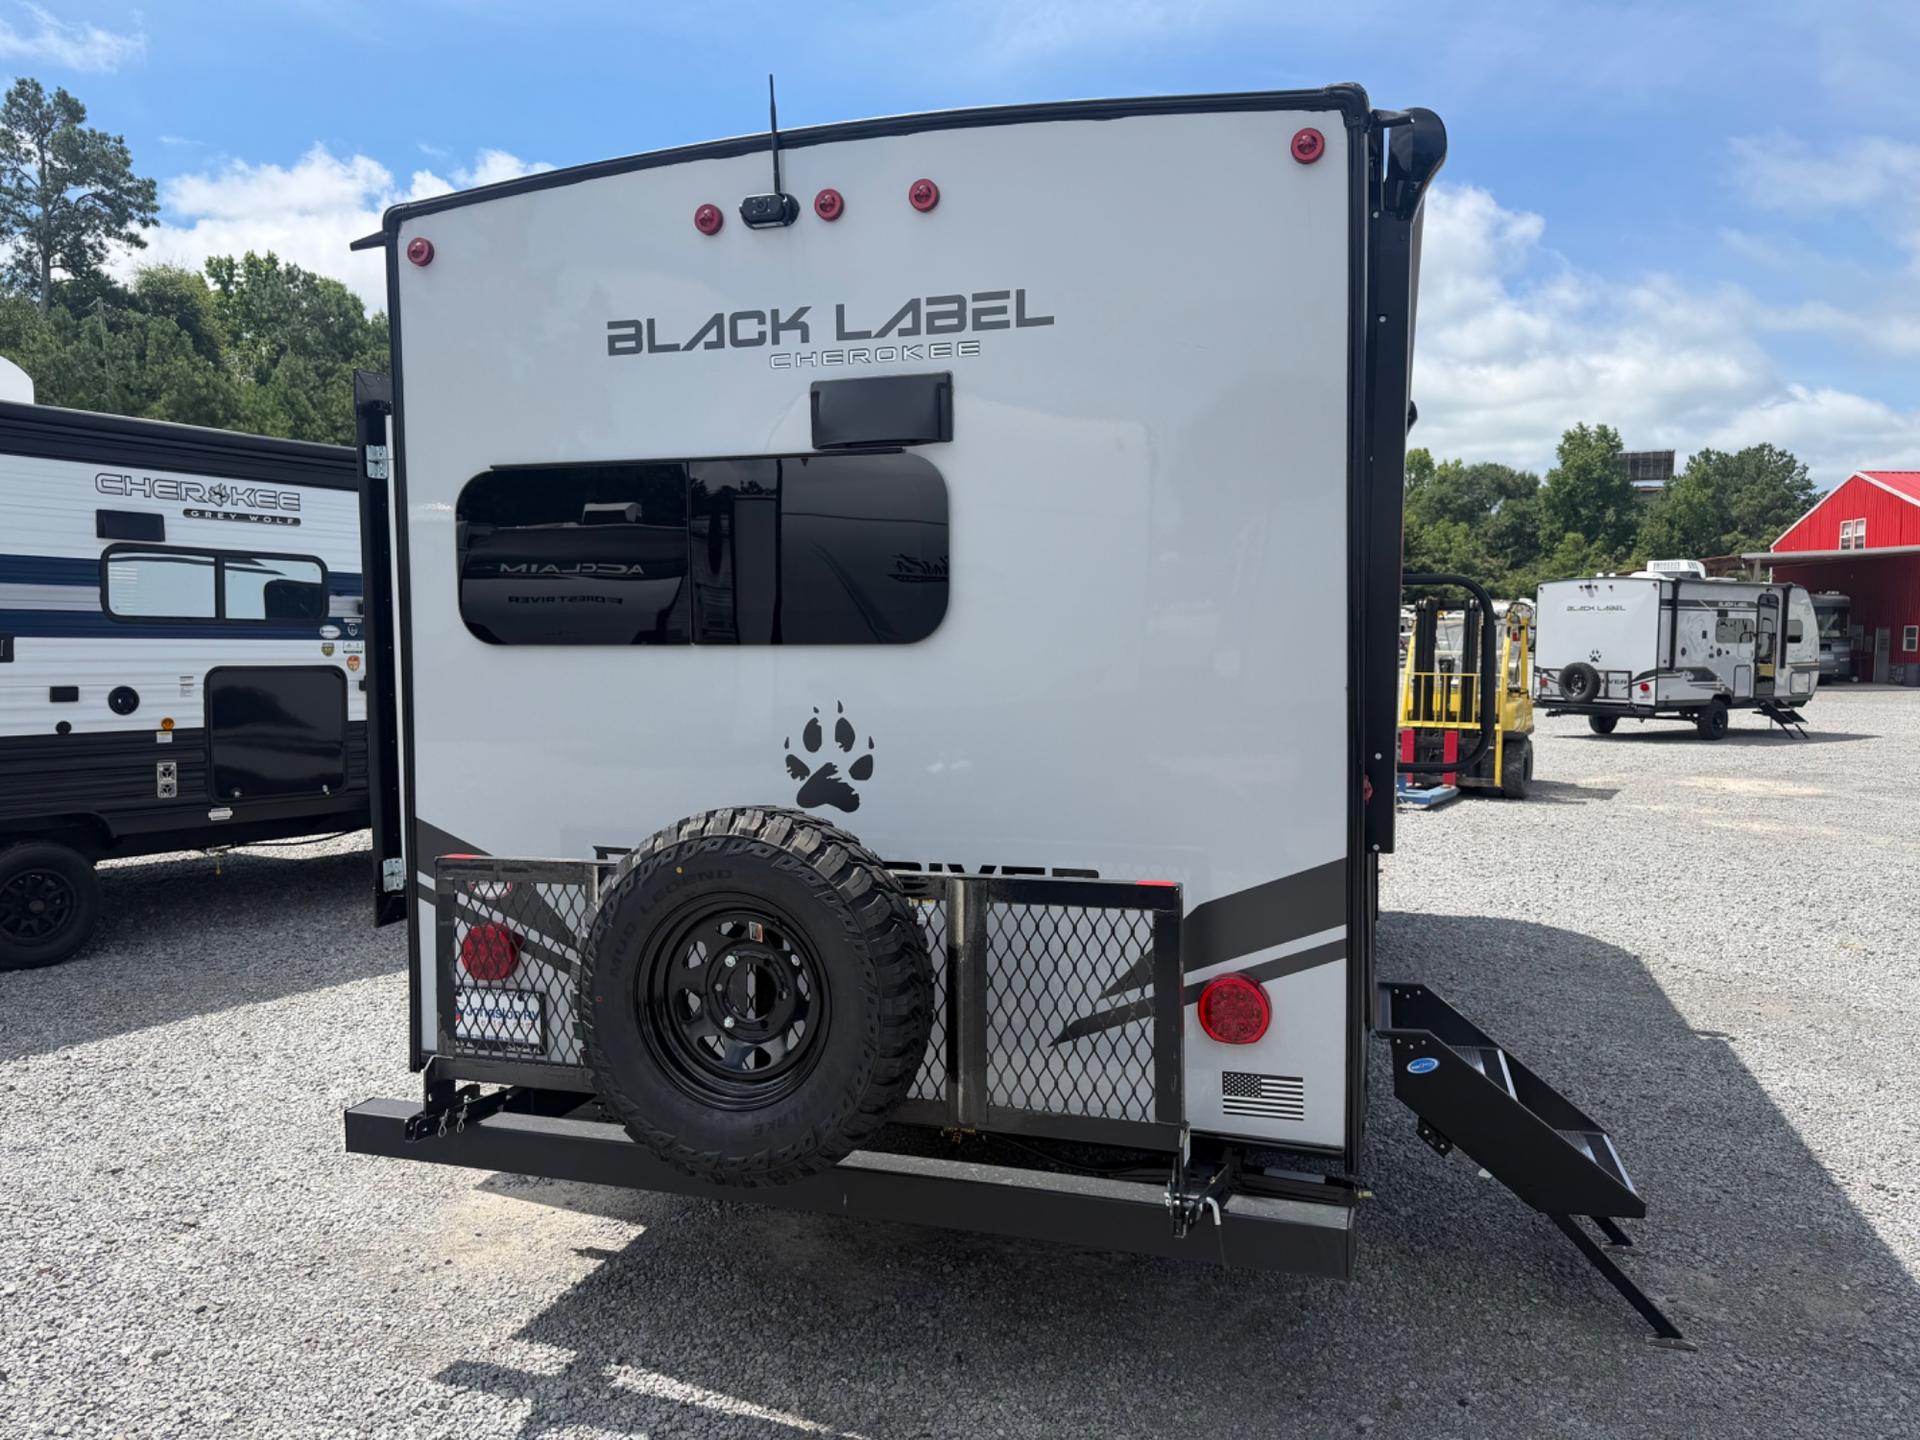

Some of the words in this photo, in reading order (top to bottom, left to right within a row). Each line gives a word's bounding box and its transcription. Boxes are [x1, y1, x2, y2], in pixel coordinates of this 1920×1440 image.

[606, 305, 813, 357] BLACK
[835, 288, 1055, 342] LABEL
[768, 339, 982, 370] CHEROKEE
[190, 509, 237, 521] GREY
[248, 514, 294, 526] WOLF
